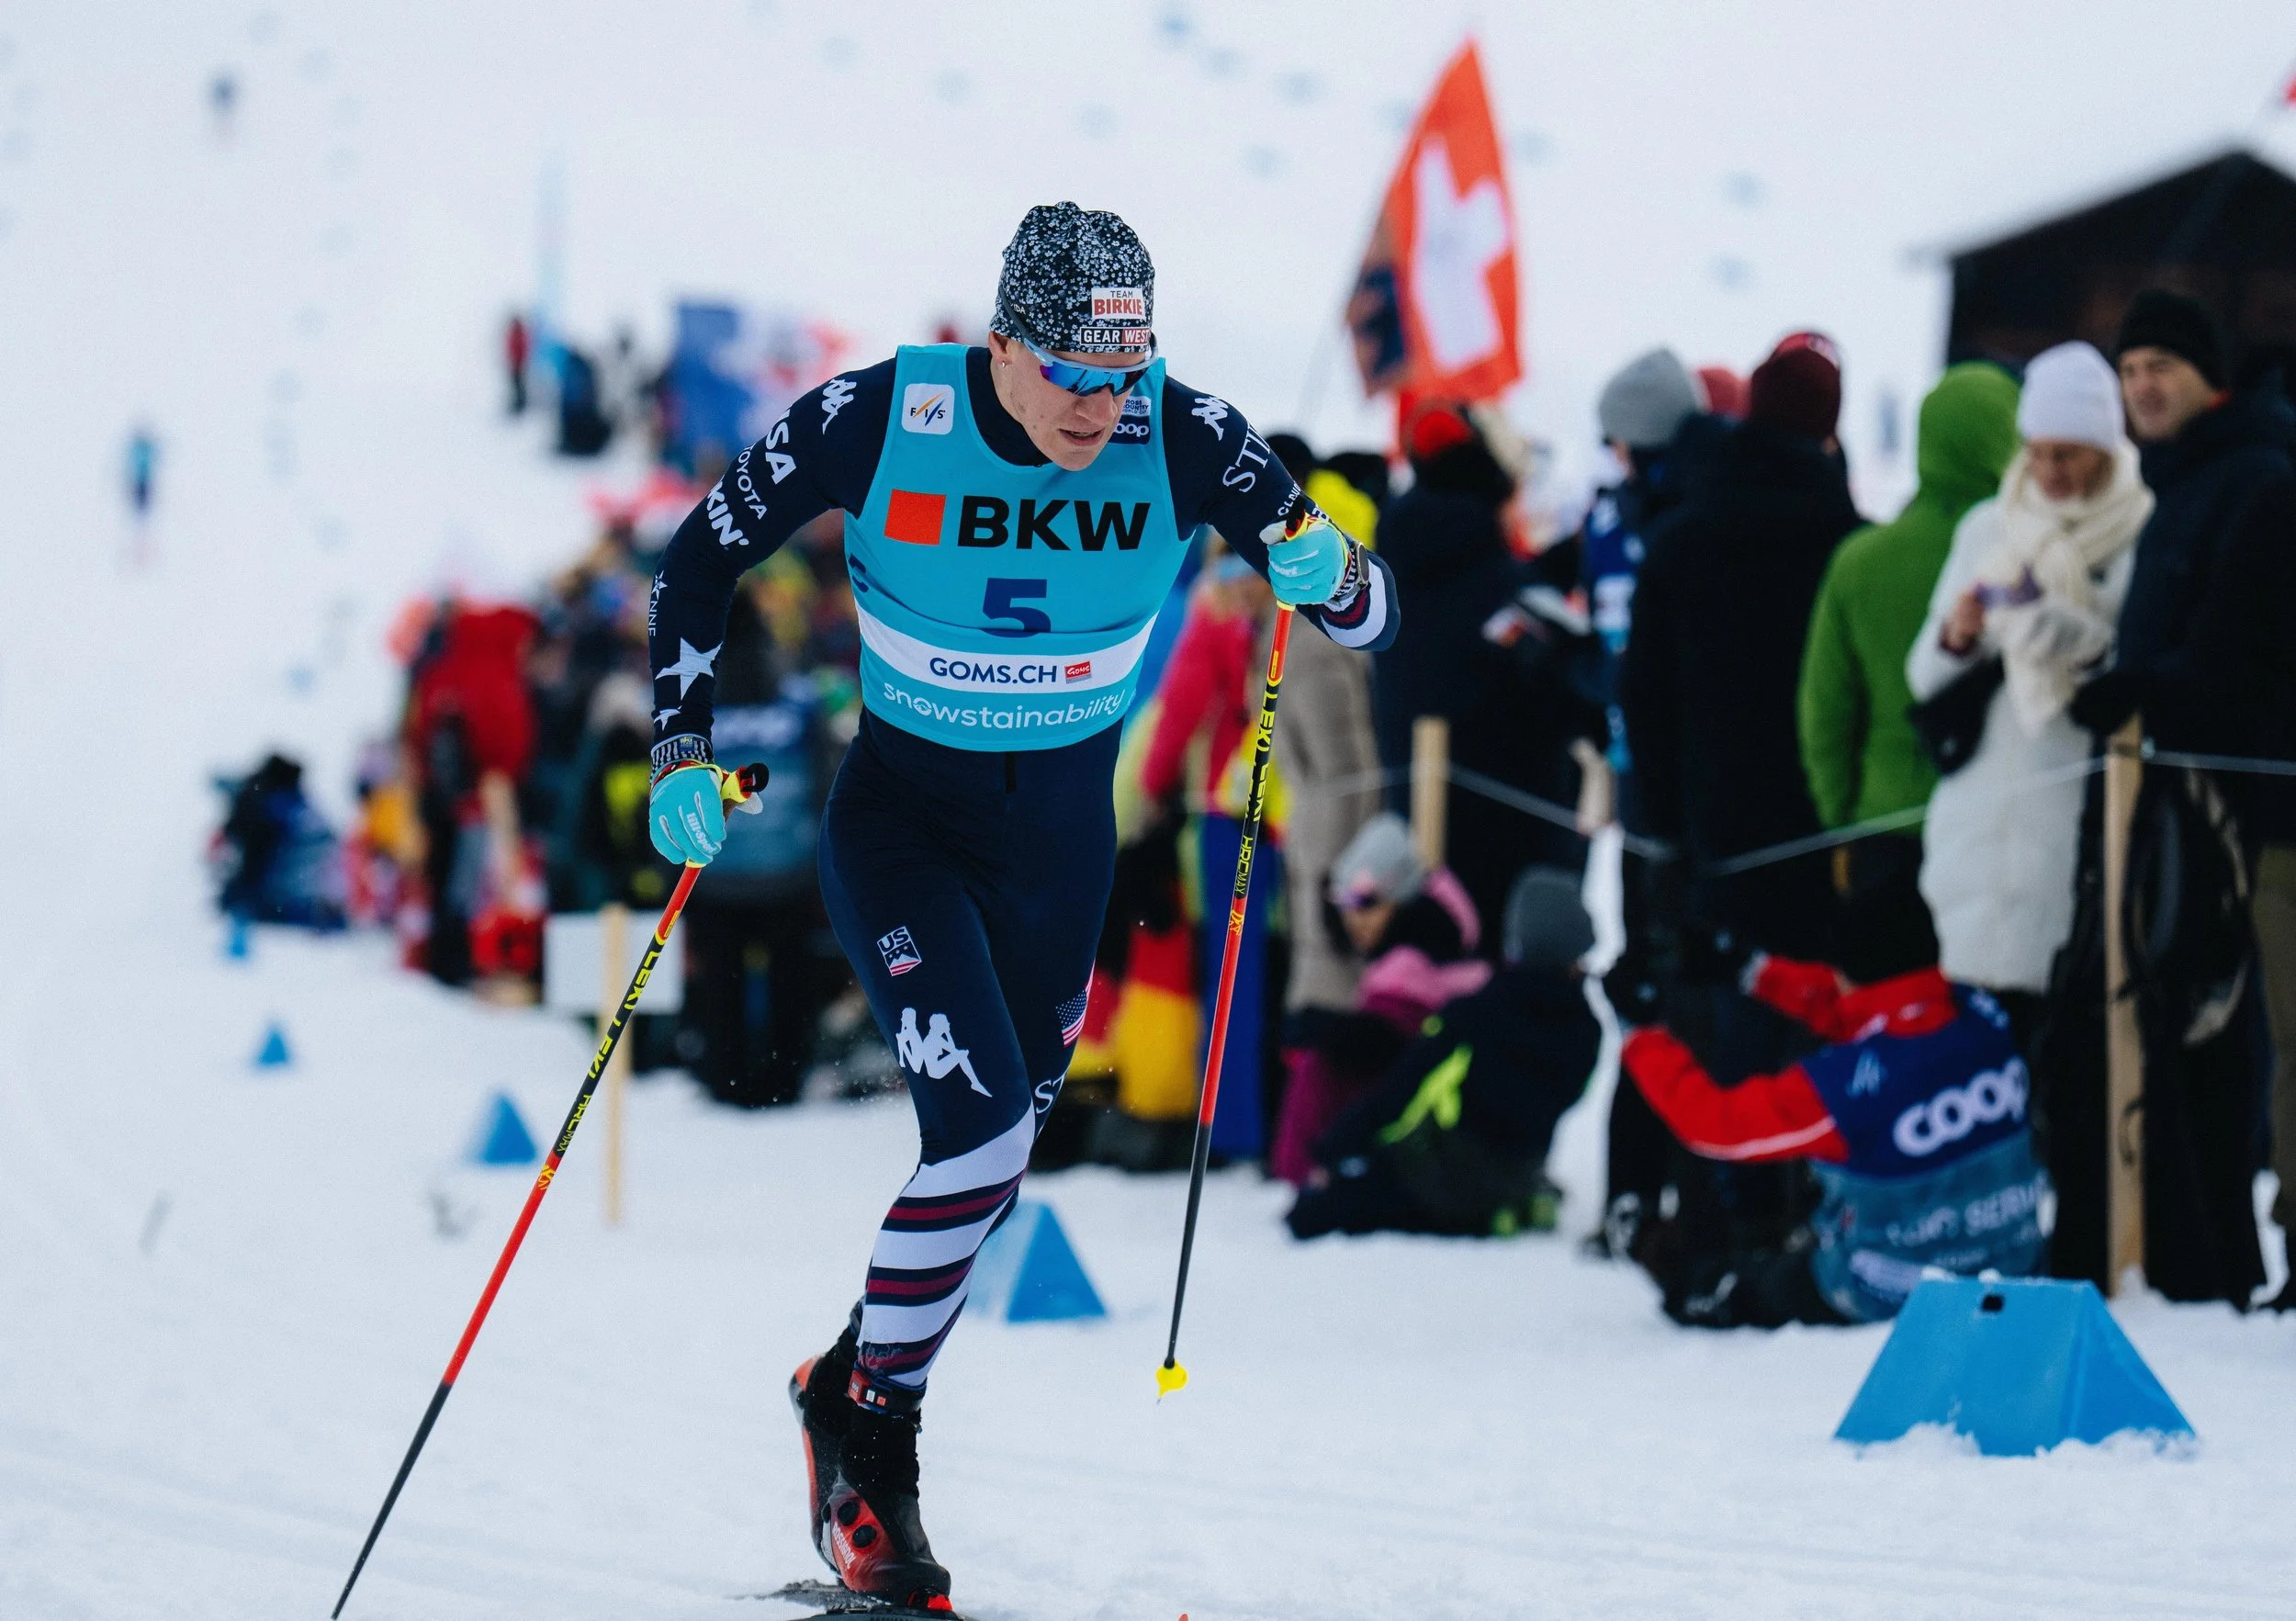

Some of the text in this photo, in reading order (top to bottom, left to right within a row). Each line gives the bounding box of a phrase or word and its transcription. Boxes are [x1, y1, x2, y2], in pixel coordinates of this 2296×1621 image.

[1094, 298, 1142, 315] BIRKIE
[1109, 290, 1133, 298] TEAM
[1084, 330, 1152, 343] GEAR WEST
[1116, 422, 1150, 438] oop
[737, 443, 768, 520] TOYOTA
[706, 480, 750, 546] KIN'
[957, 495, 1152, 551] BKW
[982, 577, 1052, 638] 5
[929, 657, 1058, 684] GOMS.CH
[884, 681, 1126, 729] snowstainability
[1255, 690, 1278, 752] LEKI
[878, 928, 910, 953] US
[624, 951, 660, 1010] LEKI
[1034, 1073, 1065, 1114] ST
